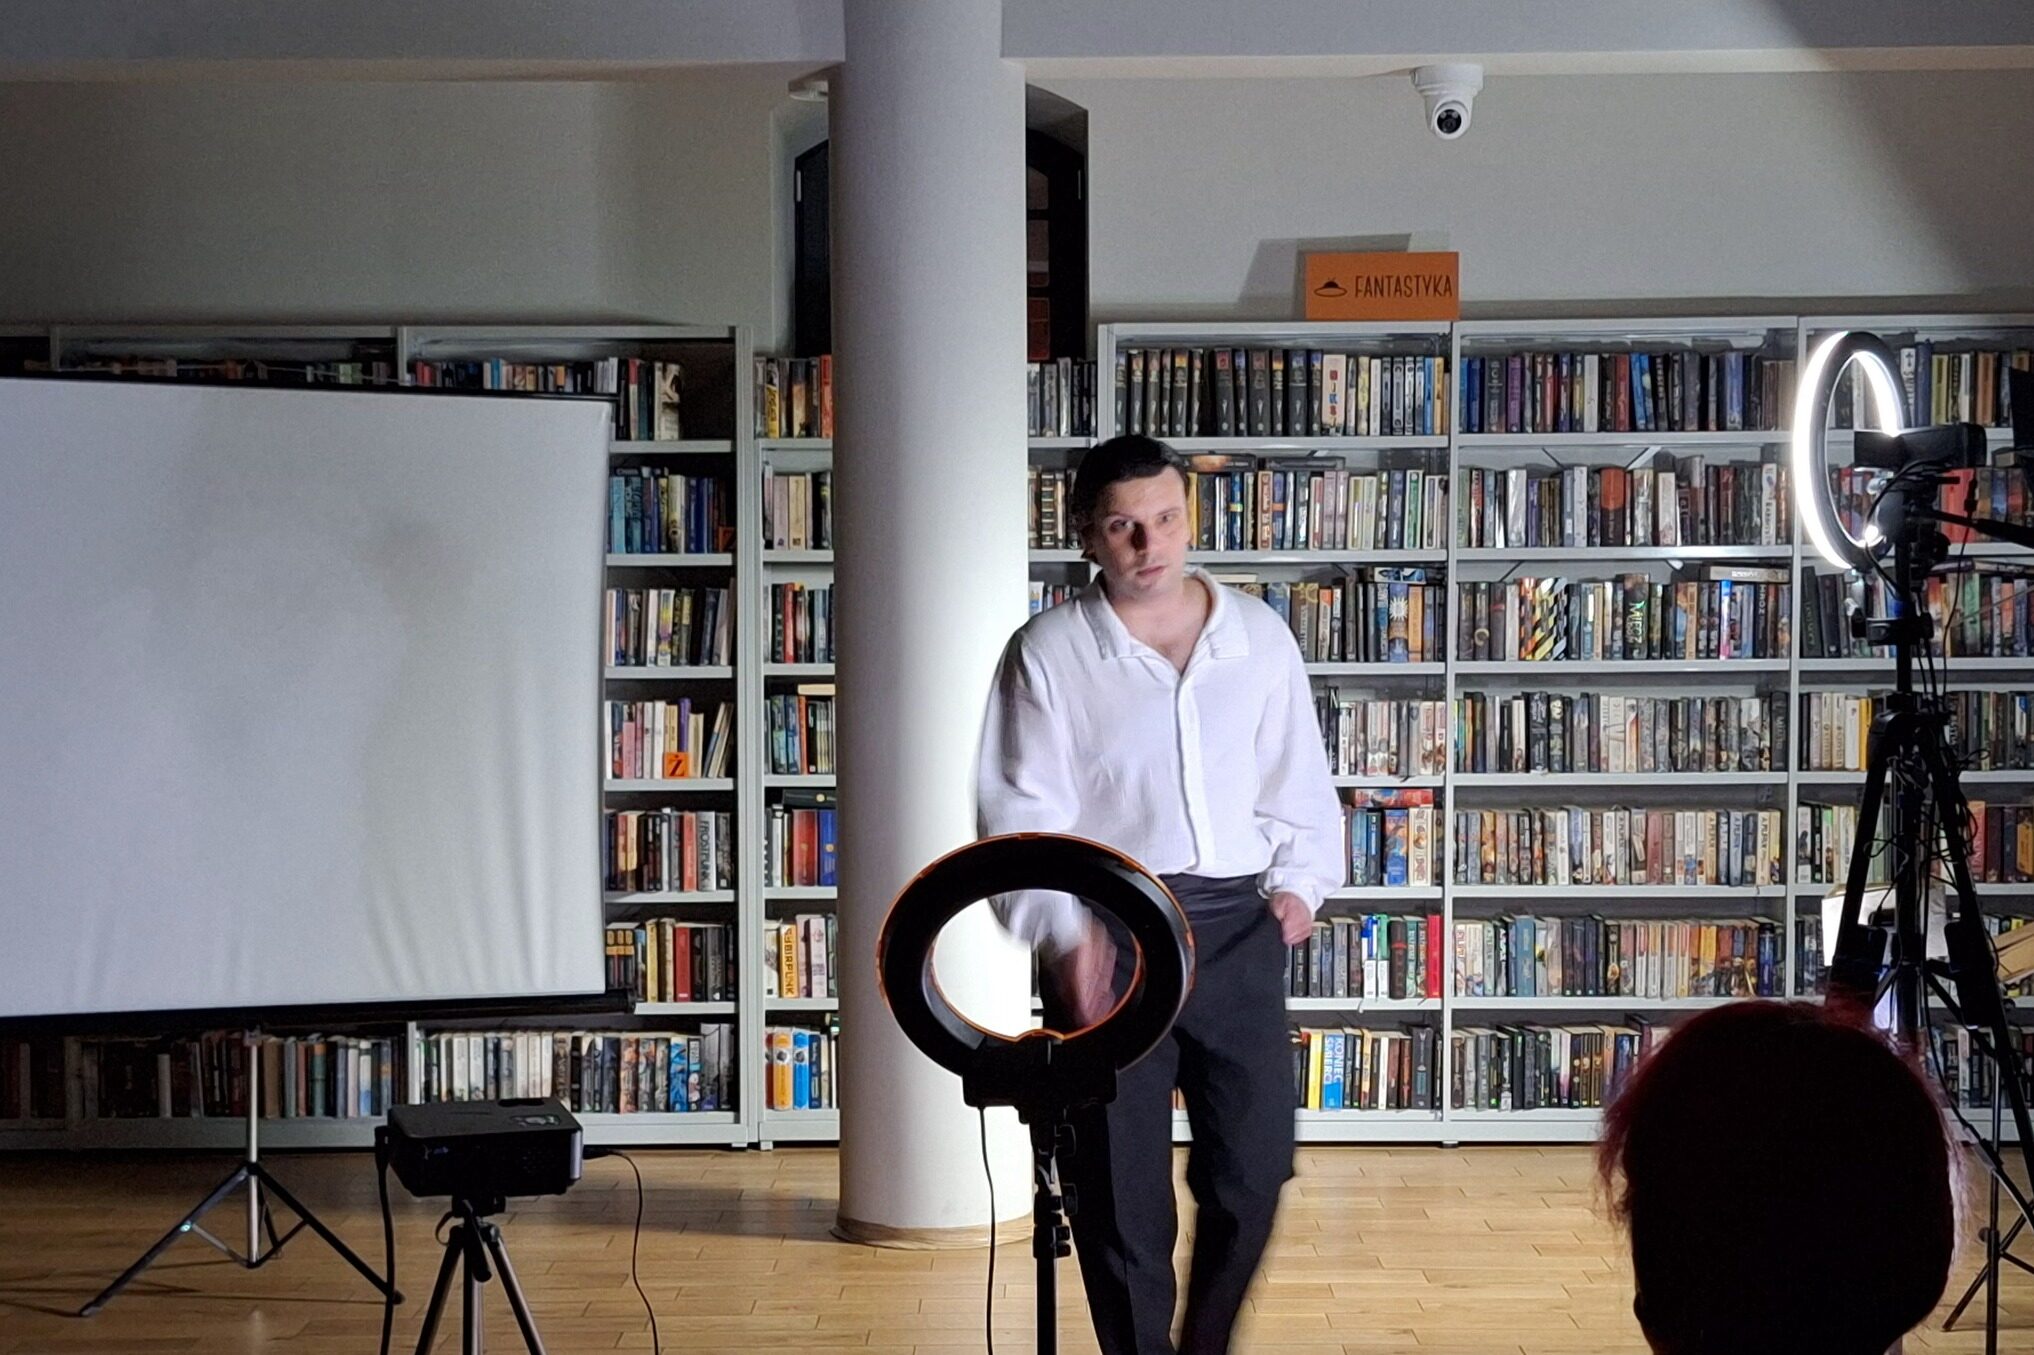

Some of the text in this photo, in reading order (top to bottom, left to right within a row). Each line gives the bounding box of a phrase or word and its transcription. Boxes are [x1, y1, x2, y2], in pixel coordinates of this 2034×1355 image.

[1355, 274, 1453, 298] FANTASTYKA
[669, 754, 685, 777] Ż
[699, 820, 711, 882] FROSTPUNK
